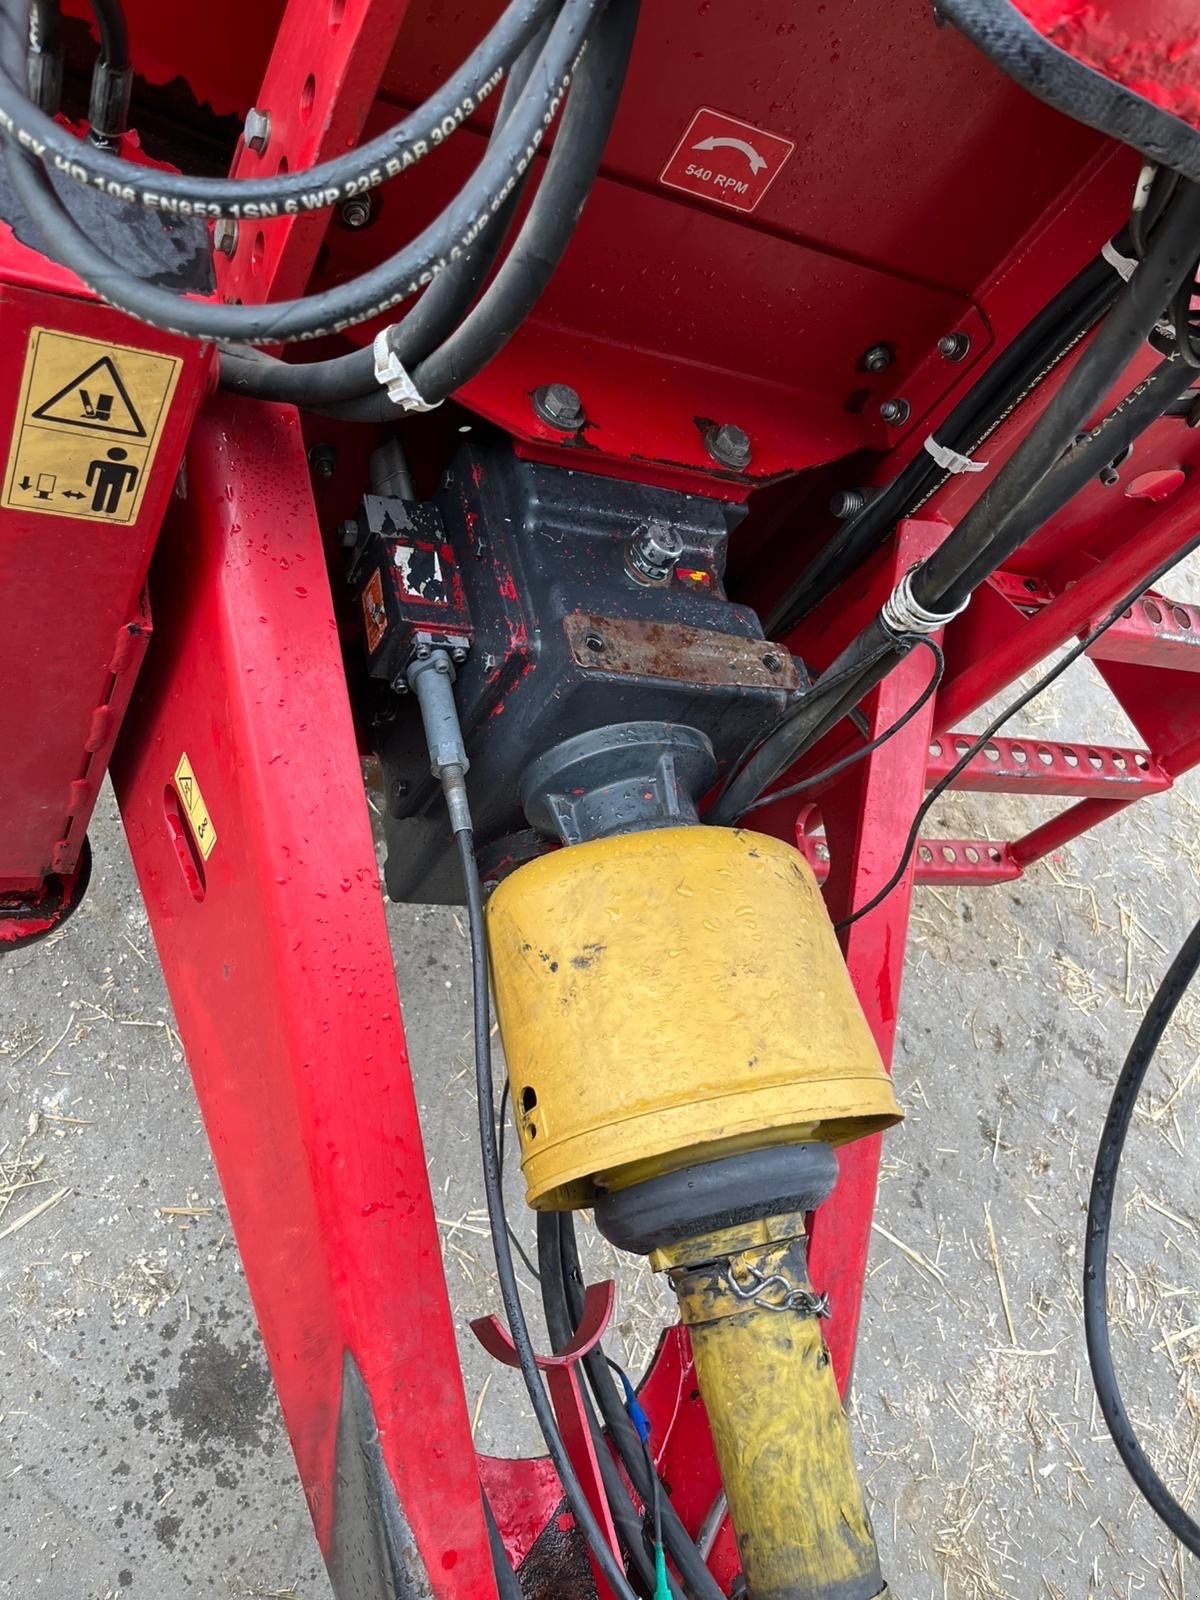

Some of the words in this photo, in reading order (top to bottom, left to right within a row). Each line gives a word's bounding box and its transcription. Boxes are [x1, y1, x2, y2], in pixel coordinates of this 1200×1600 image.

[229, 204, 278, 219] 1SN
[285, 199, 299, 215] 6
[301, 188, 341, 210] WP
[345, 168, 383, 198] 225
[385, 140, 429, 177] BAR
[685, 163, 713, 182] 540
[713, 173, 750, 195] RPM
